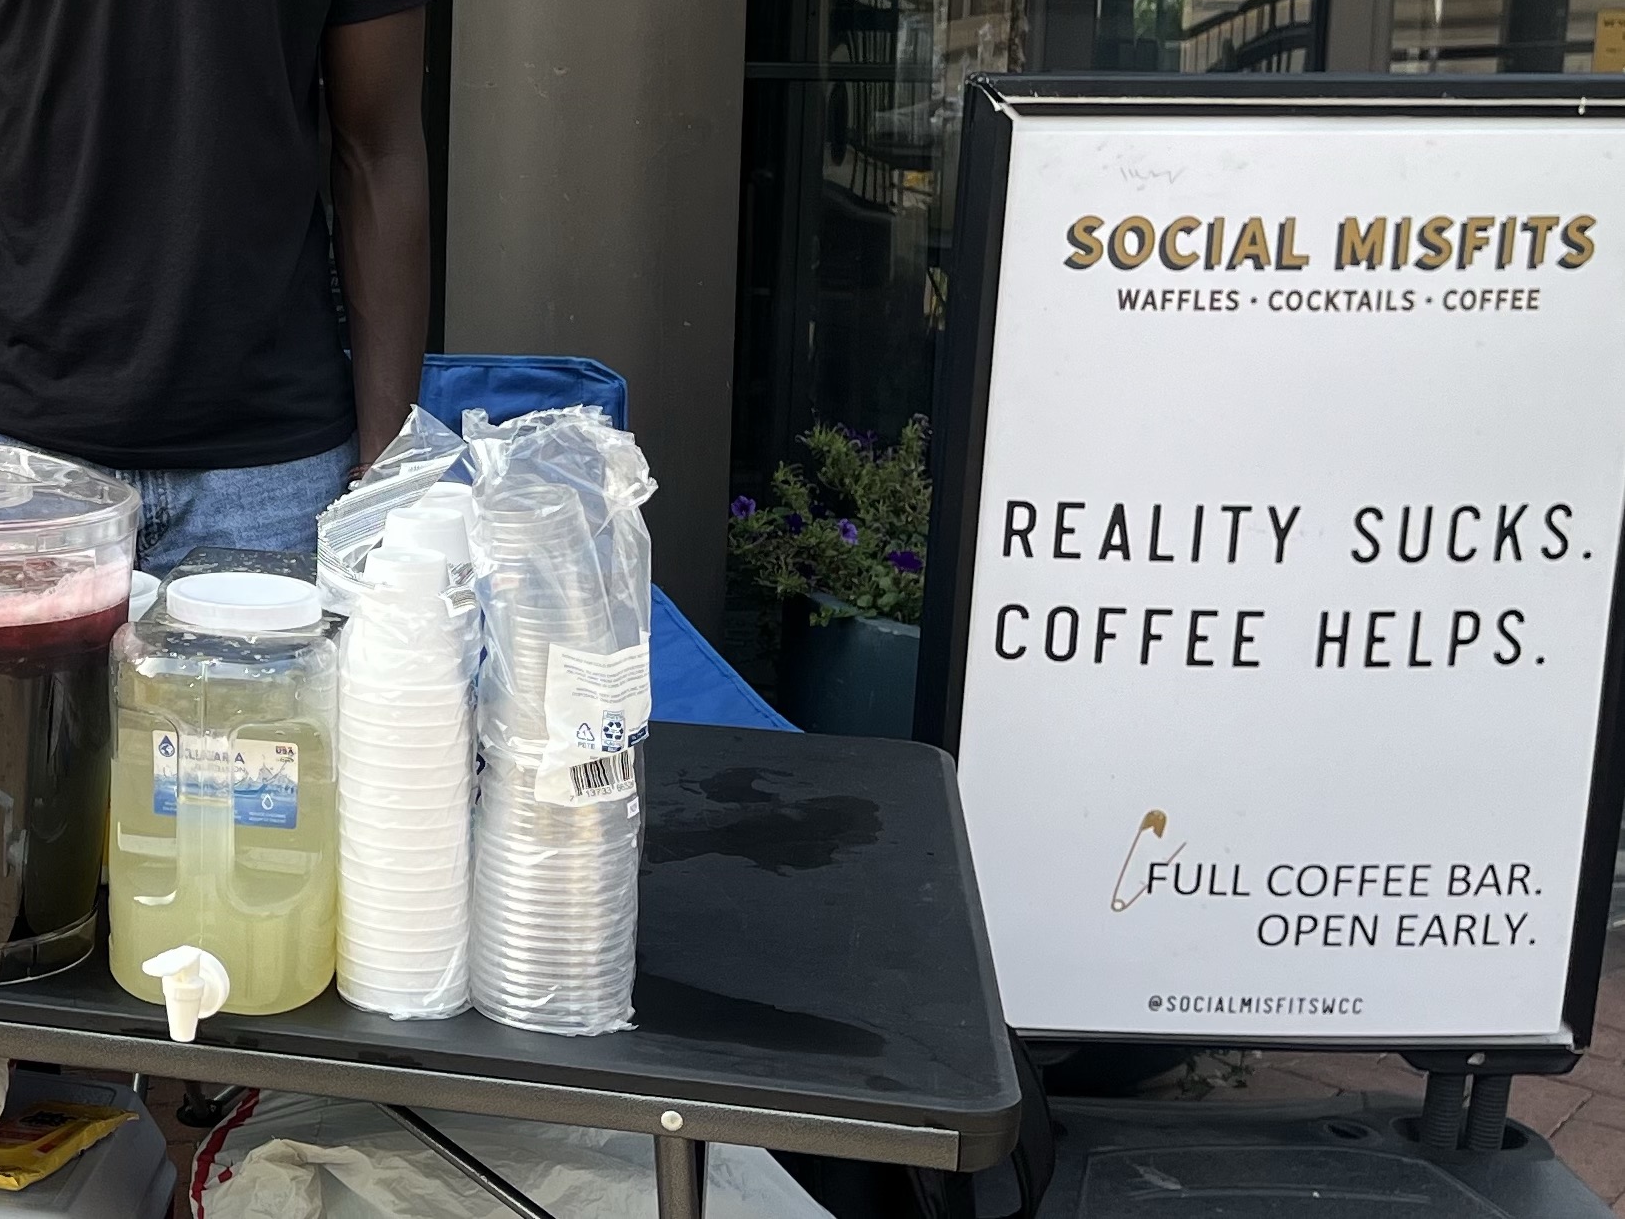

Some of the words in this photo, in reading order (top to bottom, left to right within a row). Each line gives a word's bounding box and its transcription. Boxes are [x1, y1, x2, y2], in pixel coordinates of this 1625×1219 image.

[1063, 215, 1310, 270] SOCIAL
[1334, 214, 1597, 270] MISFITS
[1117, 289, 1240, 312] WAFFLES
[1267, 289, 1415, 312] COCKTAILS
[1442, 289, 1540, 312] COFFEE
[1002, 501, 1302, 564] REALITY
[1350, 502, 1594, 563] SUCKS.
[993, 603, 1267, 668] COFFEE
[1315, 609, 1546, 668] HELPS.
[1146, 862, 1251, 897] FULL
[1265, 863, 1431, 897] COFFEE
[1446, 863, 1543, 897] BAR.
[1257, 914, 1380, 948] OPEN
[1395, 913, 1537, 948] EARLY.
[1148, 994, 1364, 1016] @SOCIALMISFITSWCC
